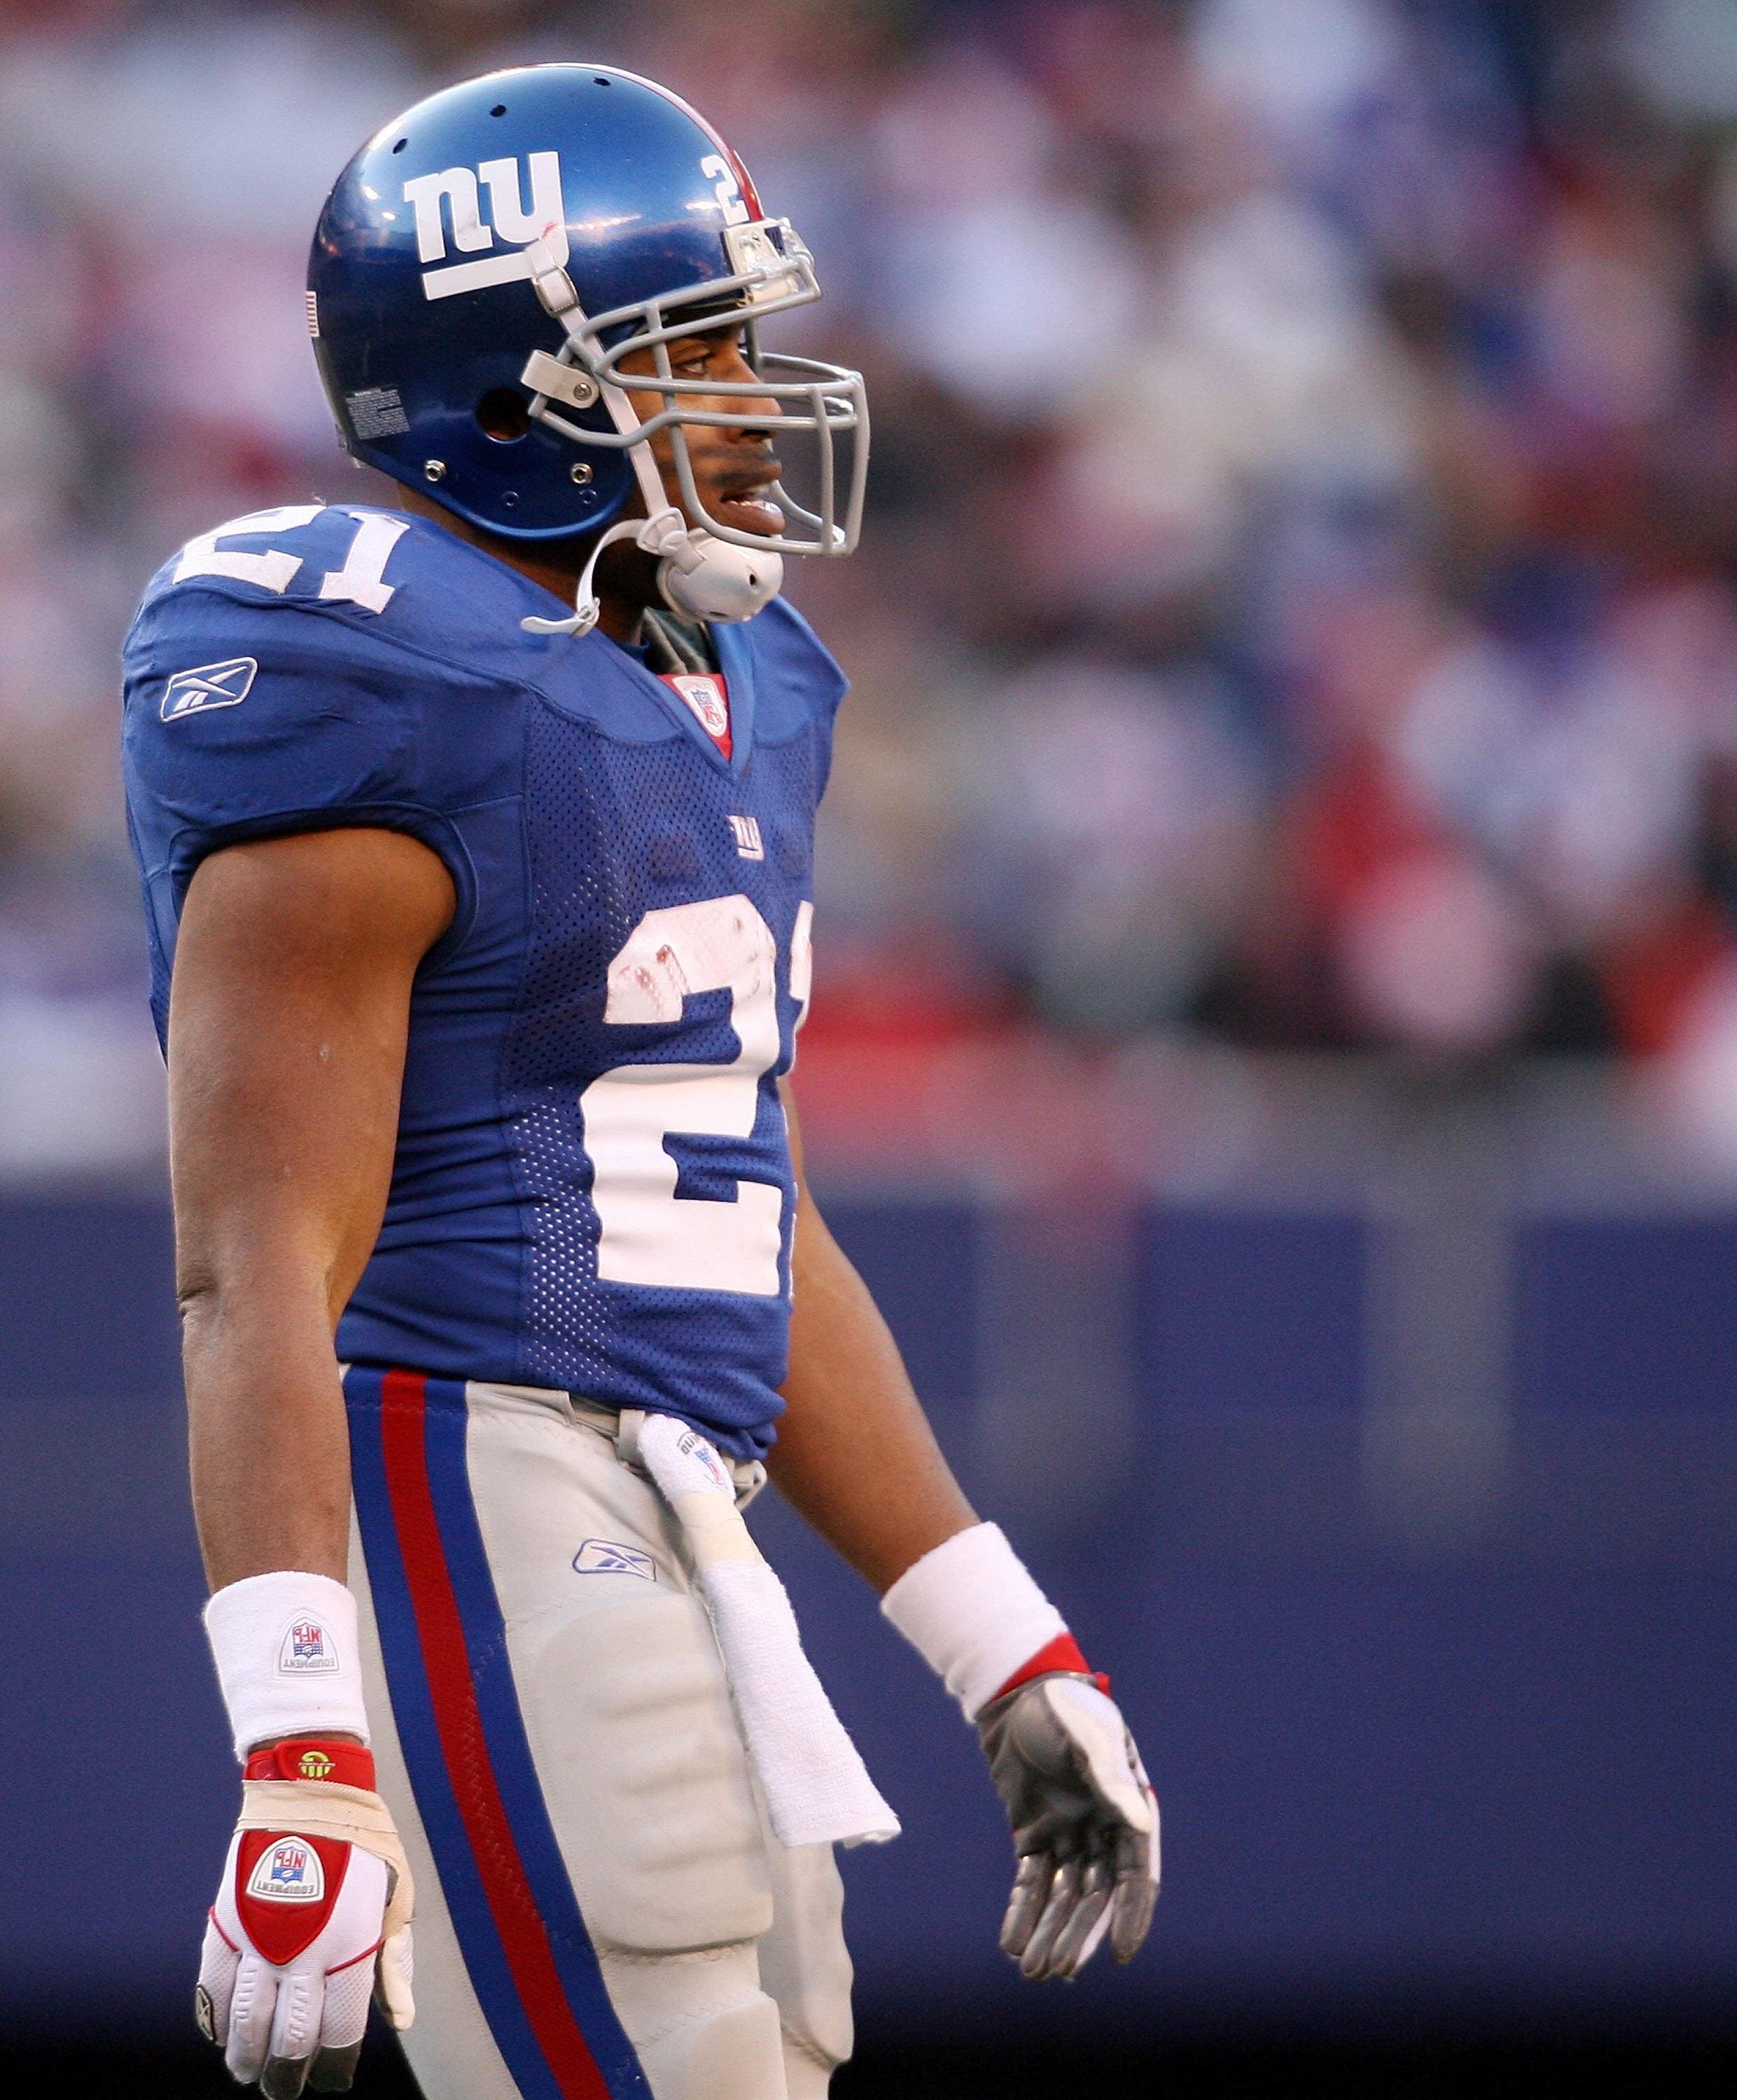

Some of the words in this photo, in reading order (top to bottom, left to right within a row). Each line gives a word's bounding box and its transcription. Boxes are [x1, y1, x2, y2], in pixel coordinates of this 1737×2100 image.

[701, 154, 750, 225] 2
[172, 505, 411, 615] 21
[293, 1625, 321, 1644] NFL
[277, 1848, 305, 1869] NFL
